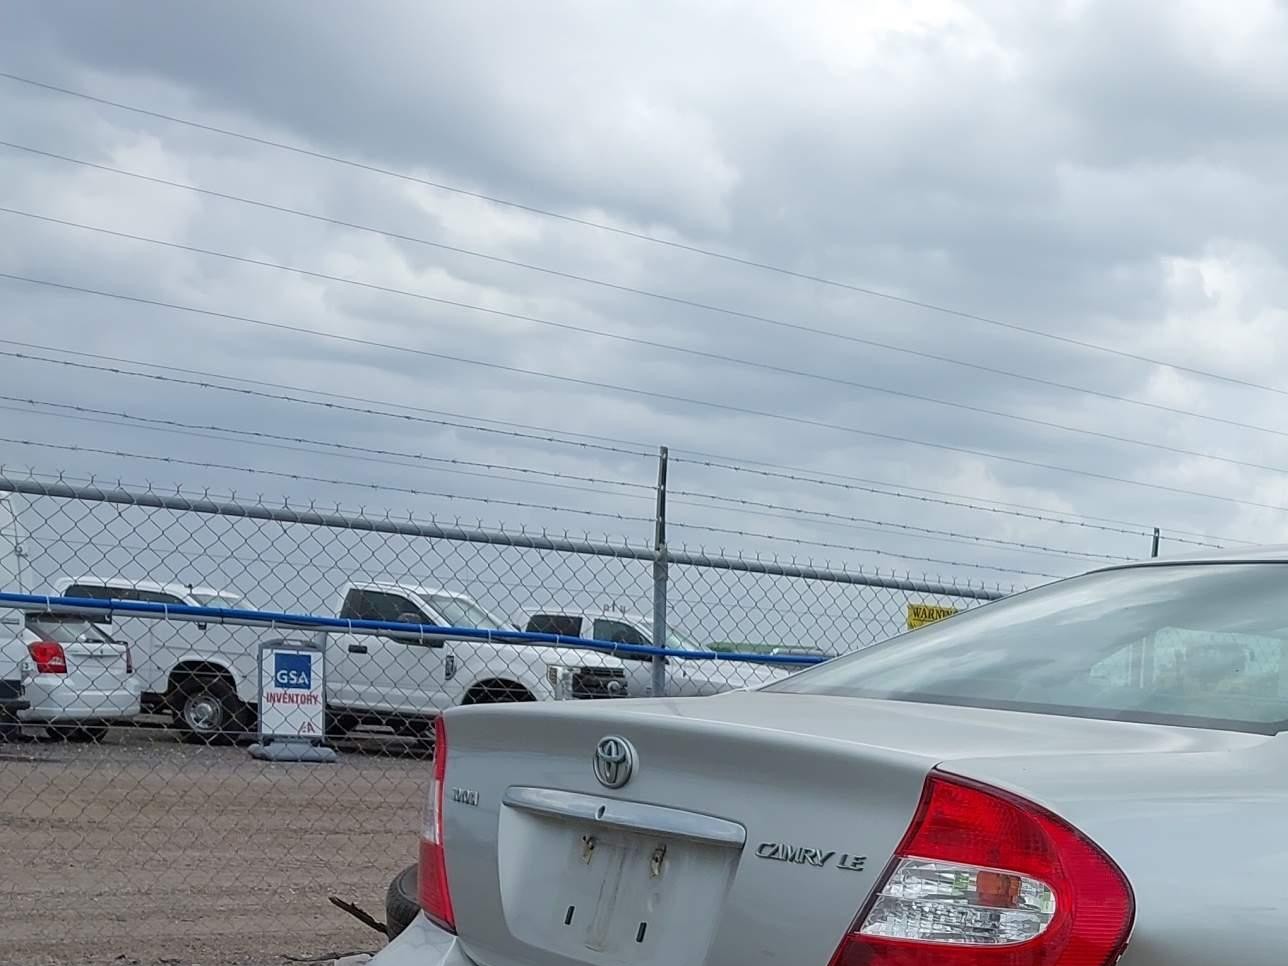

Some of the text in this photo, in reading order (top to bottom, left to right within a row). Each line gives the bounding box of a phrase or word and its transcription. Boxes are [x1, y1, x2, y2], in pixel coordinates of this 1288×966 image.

[277, 670, 309, 684] GSA
[267, 692, 319, 704] INVENTORY
[754, 842, 868, 872] CAMRY LE
